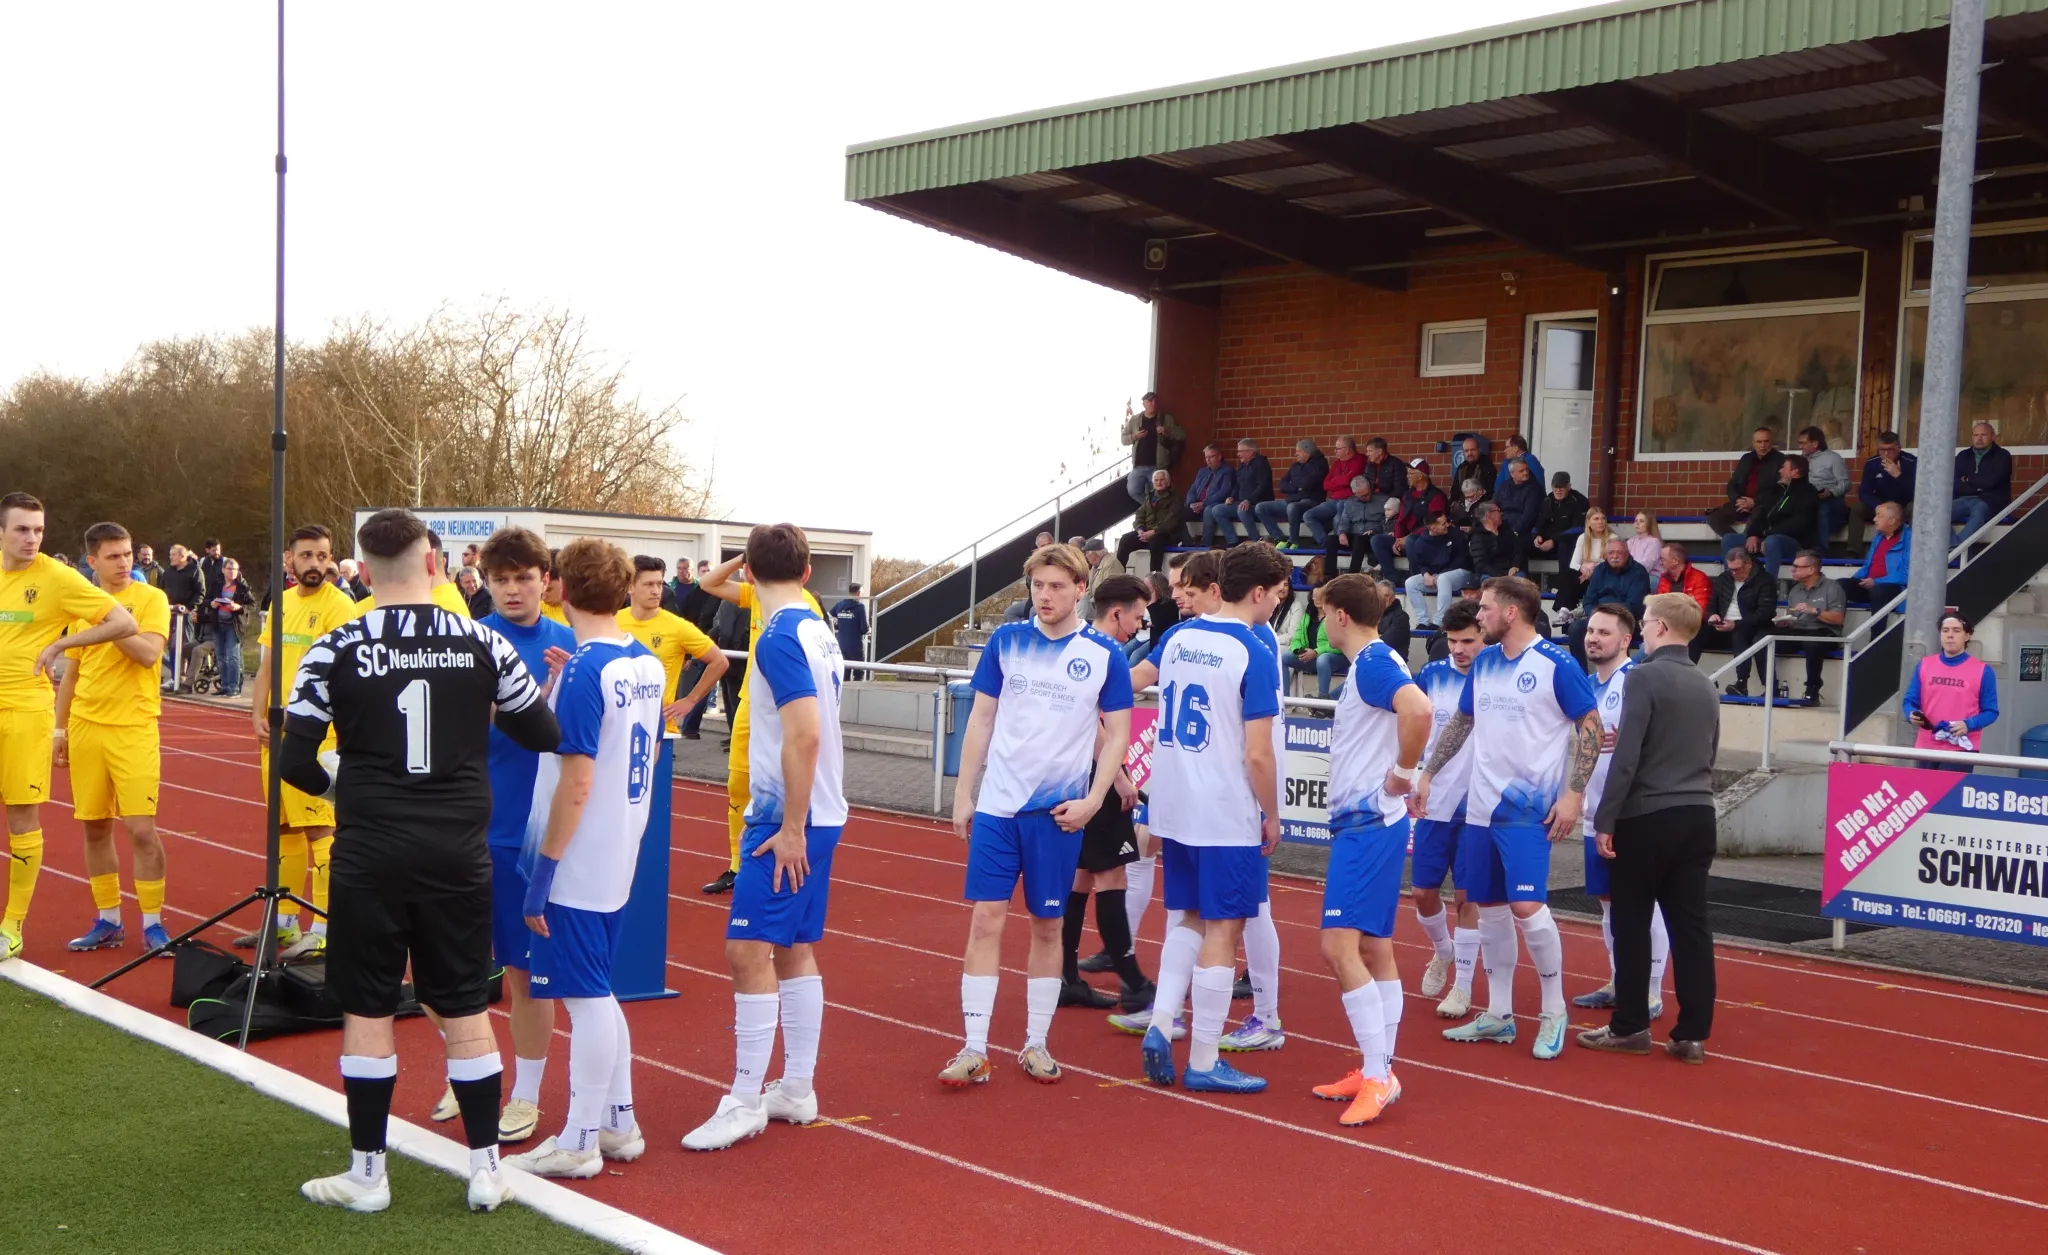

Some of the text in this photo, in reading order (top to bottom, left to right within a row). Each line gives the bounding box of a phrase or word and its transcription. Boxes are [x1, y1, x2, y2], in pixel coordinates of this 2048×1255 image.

[430, 520, 495, 537] 1899 NEUKIRCHEN
[356, 643, 474, 677] SC Neukirchen
[1177, 647, 1223, 668] Neukirchen
[1029, 688, 1051, 698] SPORT
[1057, 694, 1076, 703] MODE
[1031, 679, 1068, 692] GUNDLACH
[397, 679, 431, 773] 1
[1158, 680, 1211, 753] 16
[628, 722, 651, 804] 8
[1962, 786, 2048, 816] Das Best
[1835, 811, 1870, 841] Die
[1839, 789, 1929, 872] der Region
[1516, 884, 1535, 892] JAKO
[730, 918, 749, 927] JAKO
[1325, 909, 1342, 917] JAKO
[1851, 897, 1892, 916] Treysa
[1901, 904, 1926, 921] Tel.:
[1975, 914, 2023, 934] 927320
[365, 1155, 373, 1178] SOCKS
